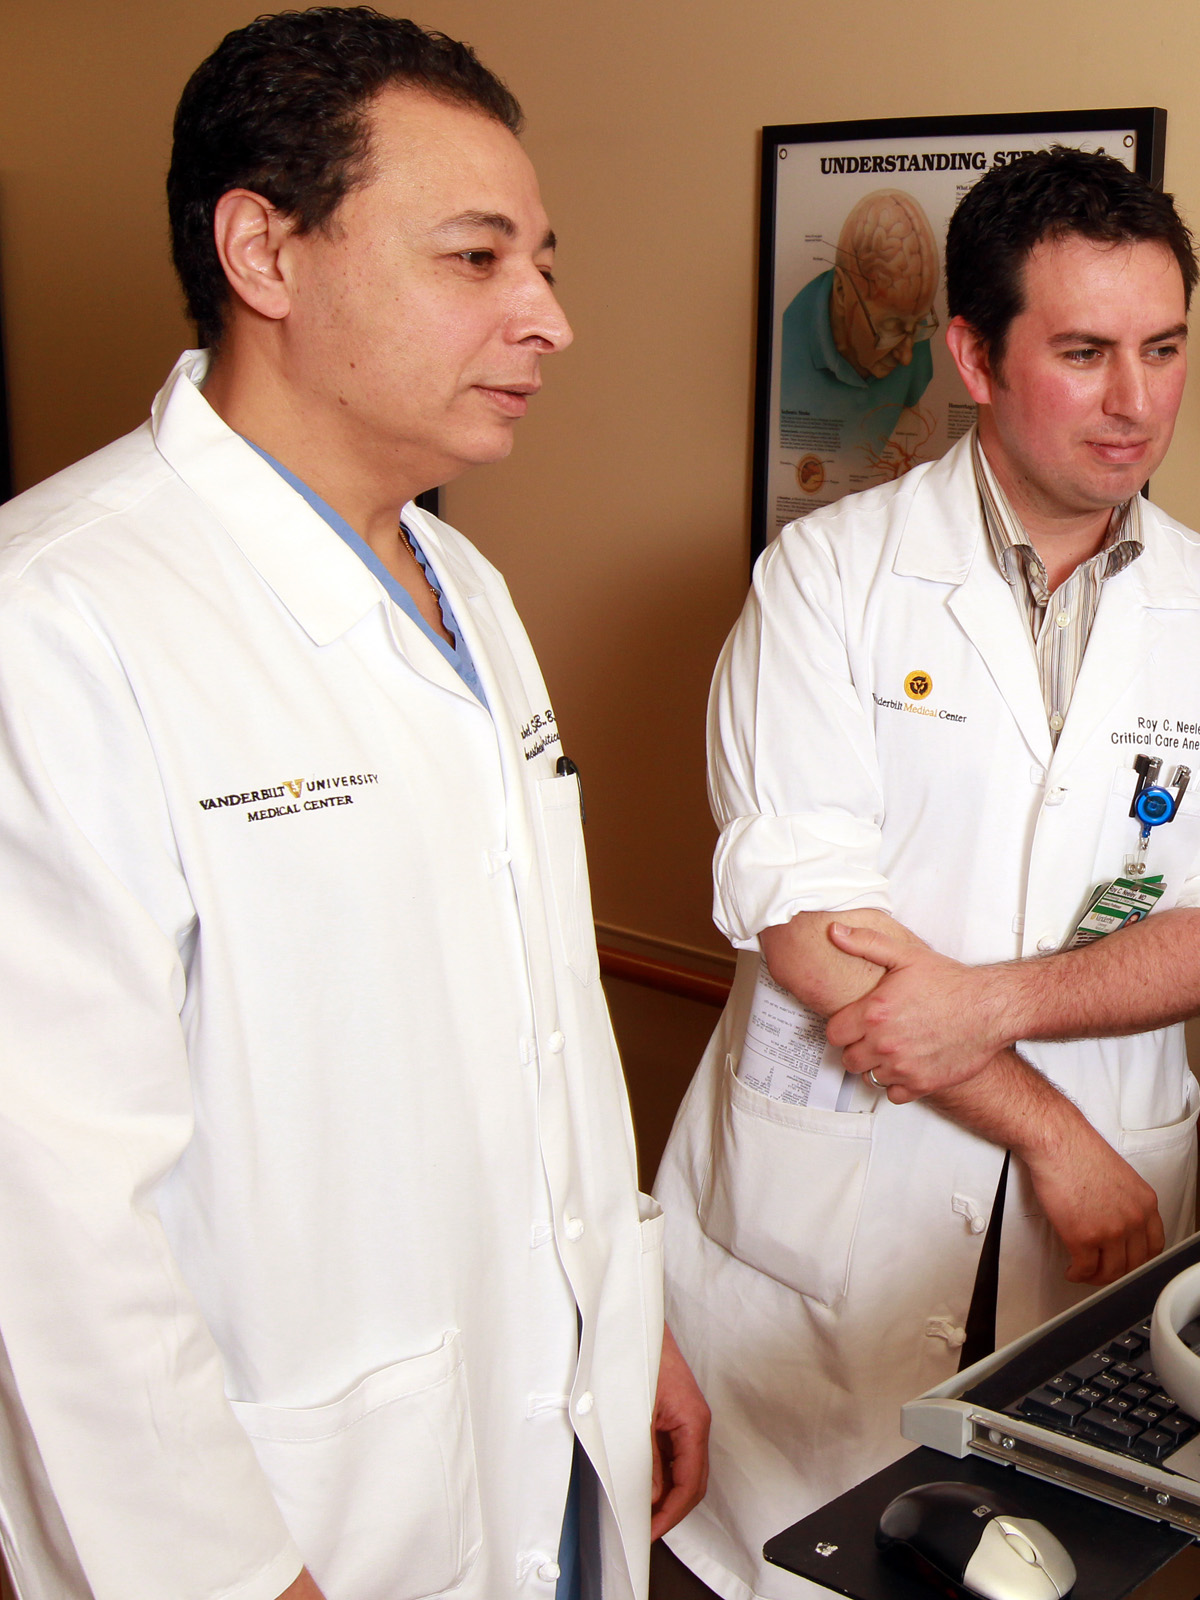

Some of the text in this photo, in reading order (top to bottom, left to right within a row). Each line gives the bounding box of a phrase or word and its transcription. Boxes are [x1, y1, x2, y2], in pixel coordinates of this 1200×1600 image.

[820, 152, 987, 174] UNDERSTANDING
[902, 702, 938, 718] Medical
[938, 710, 967, 723] Center
[1137, 716, 1158, 732] Roy
[1163, 719, 1173, 732] C.
[1111, 732, 1152, 745] Critical
[1155, 734, 1179, 748] Care
[199, 785, 286, 811] VANDERBILT
[306, 773, 380, 792] UNIVERSITY
[247, 795, 354, 822] MEDICAL CENTER
